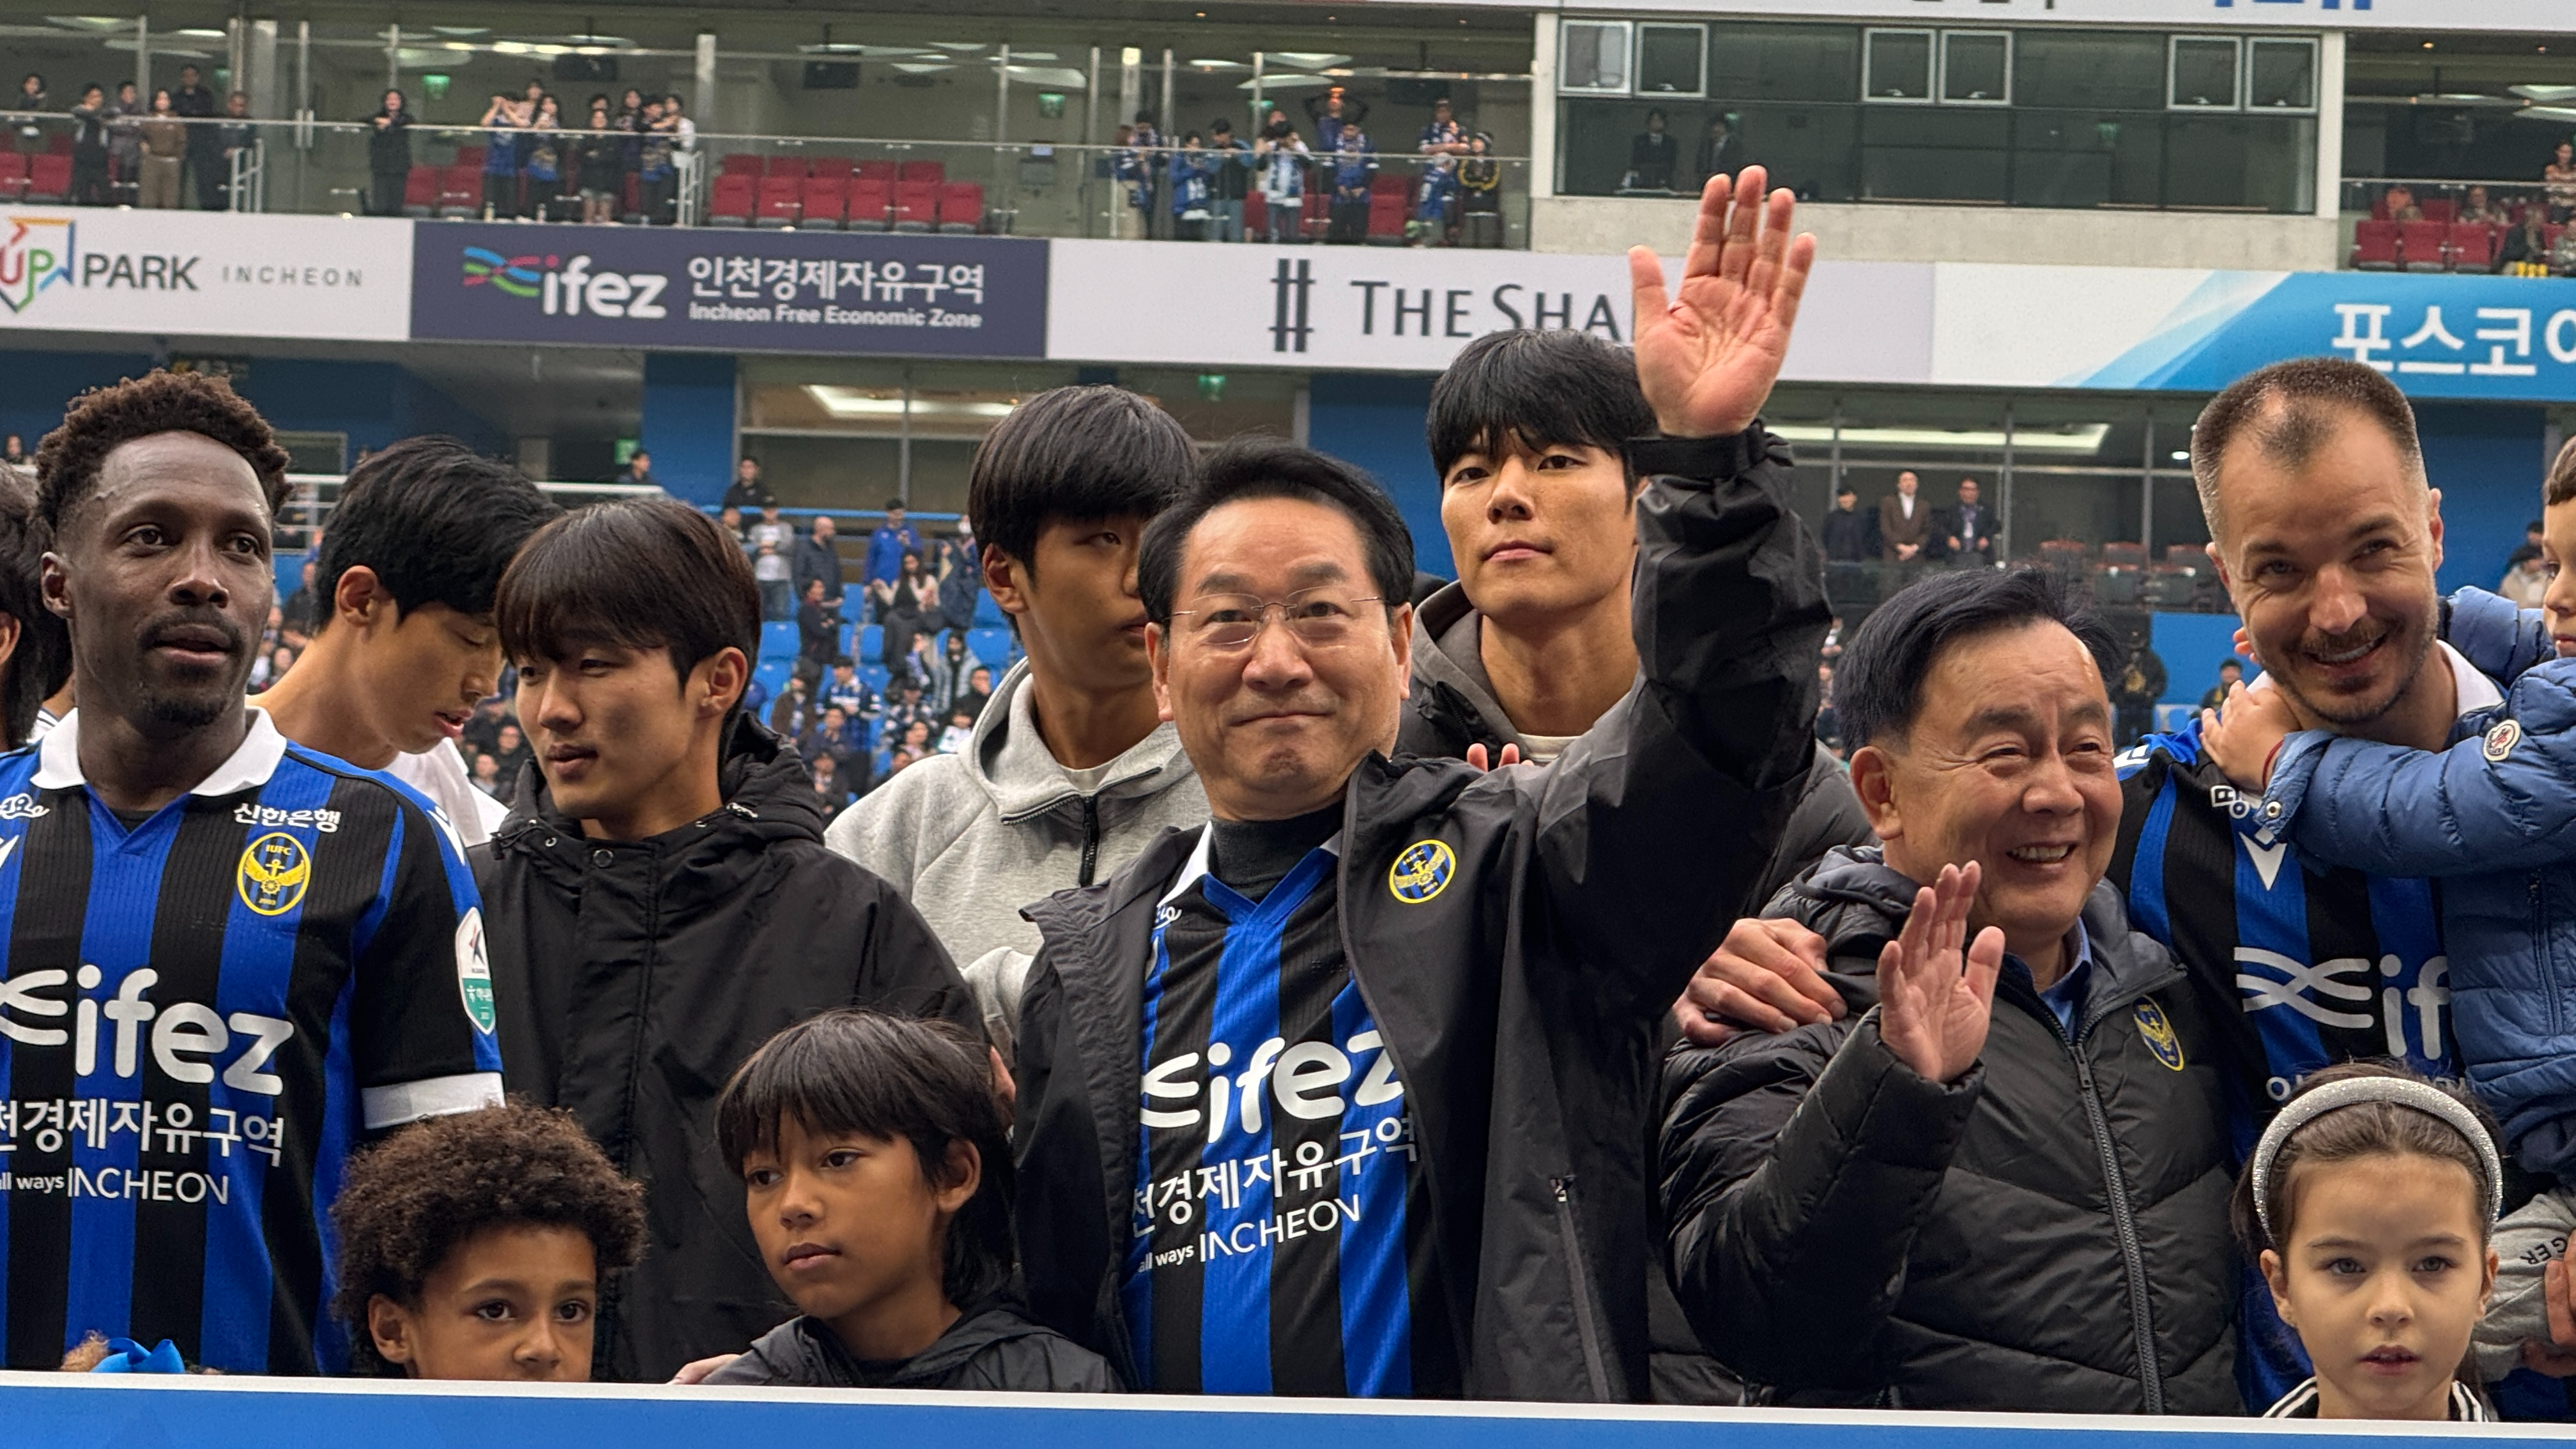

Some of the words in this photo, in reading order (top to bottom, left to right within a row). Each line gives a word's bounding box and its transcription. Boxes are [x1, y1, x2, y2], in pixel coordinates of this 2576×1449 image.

[84, 254, 199, 289] PARK
[222, 265, 363, 287] INCHEON
[542, 256, 668, 319] ifez
[688, 256, 985, 304] 인천경제자유구역
[689, 301, 771, 322] Incheon
[775, 303, 821, 323] Free
[824, 305, 926, 326] Economic
[928, 309, 982, 328] Zone
[1351, 280, 1473, 338] THE
[1492, 283, 1636, 342] SHA
[234, 802, 342, 833] 신한은행
[75, 964, 295, 1096] ifez
[15, 1176, 64, 1194] ways
[1155, 1245, 1194, 1266] ways
